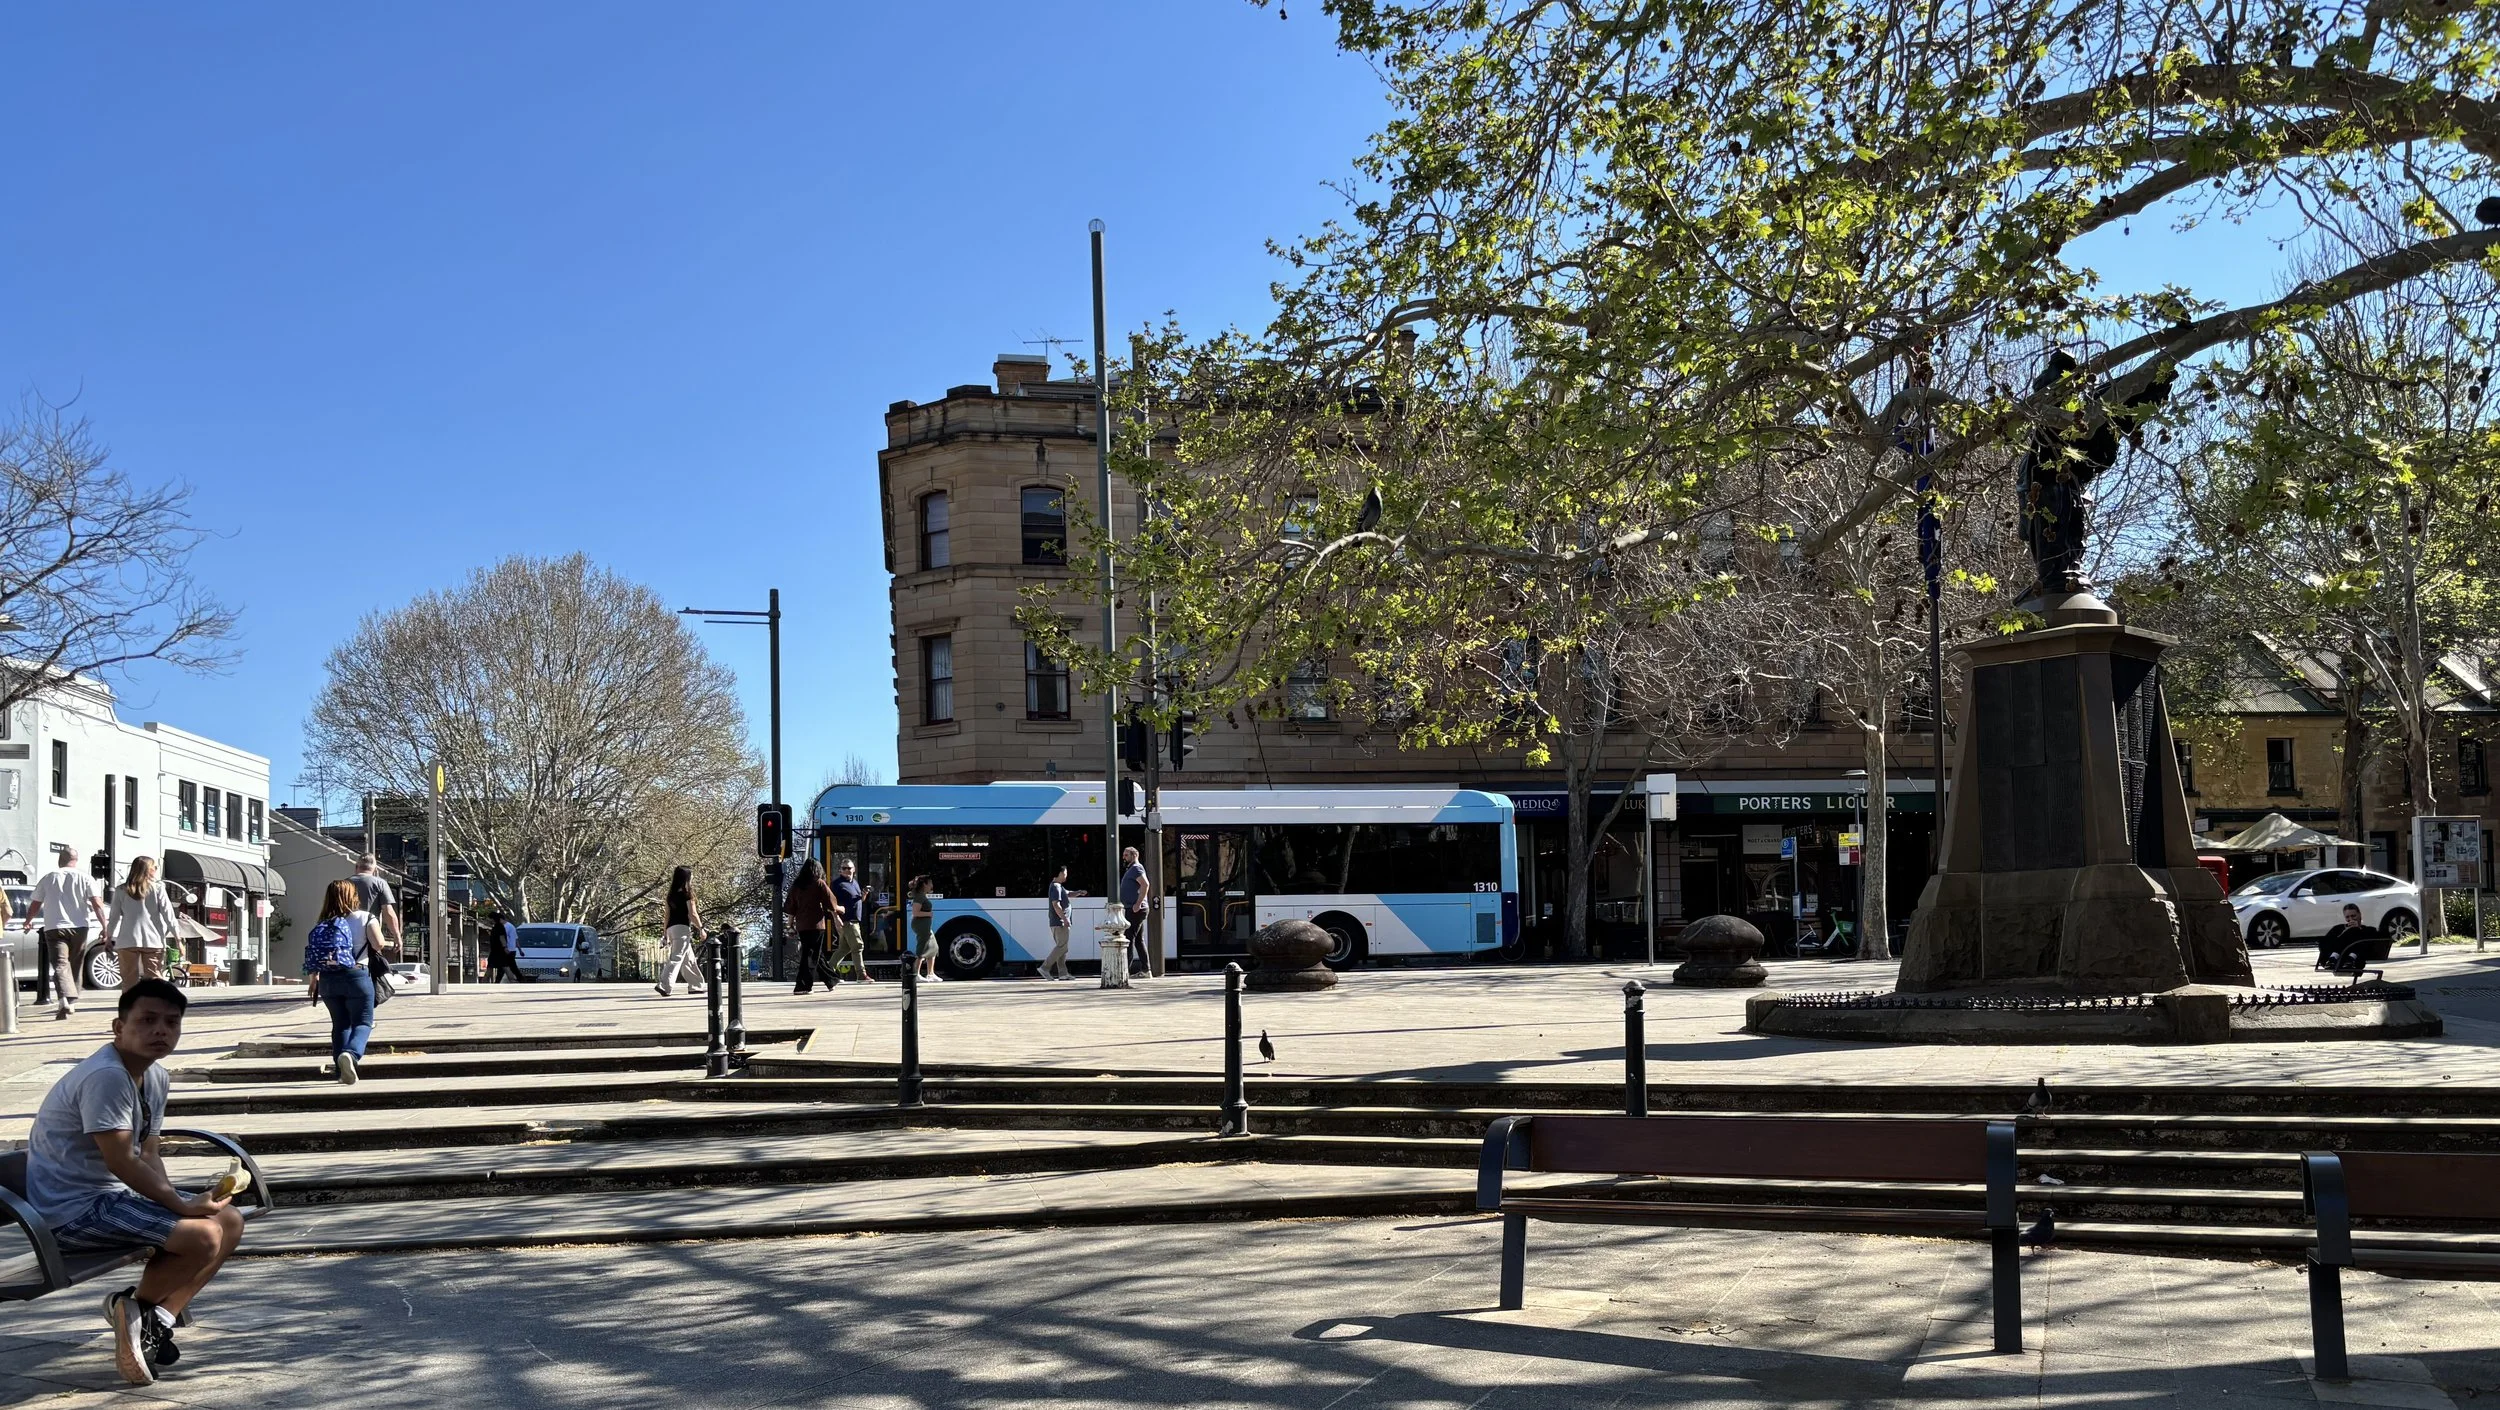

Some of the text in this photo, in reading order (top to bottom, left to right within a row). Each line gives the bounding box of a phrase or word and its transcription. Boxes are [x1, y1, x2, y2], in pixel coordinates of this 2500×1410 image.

[1739, 796, 1896, 810] PORTERS LIQUR
[845, 814, 864, 822] 1310
[1473, 881, 1498, 892] 1310
